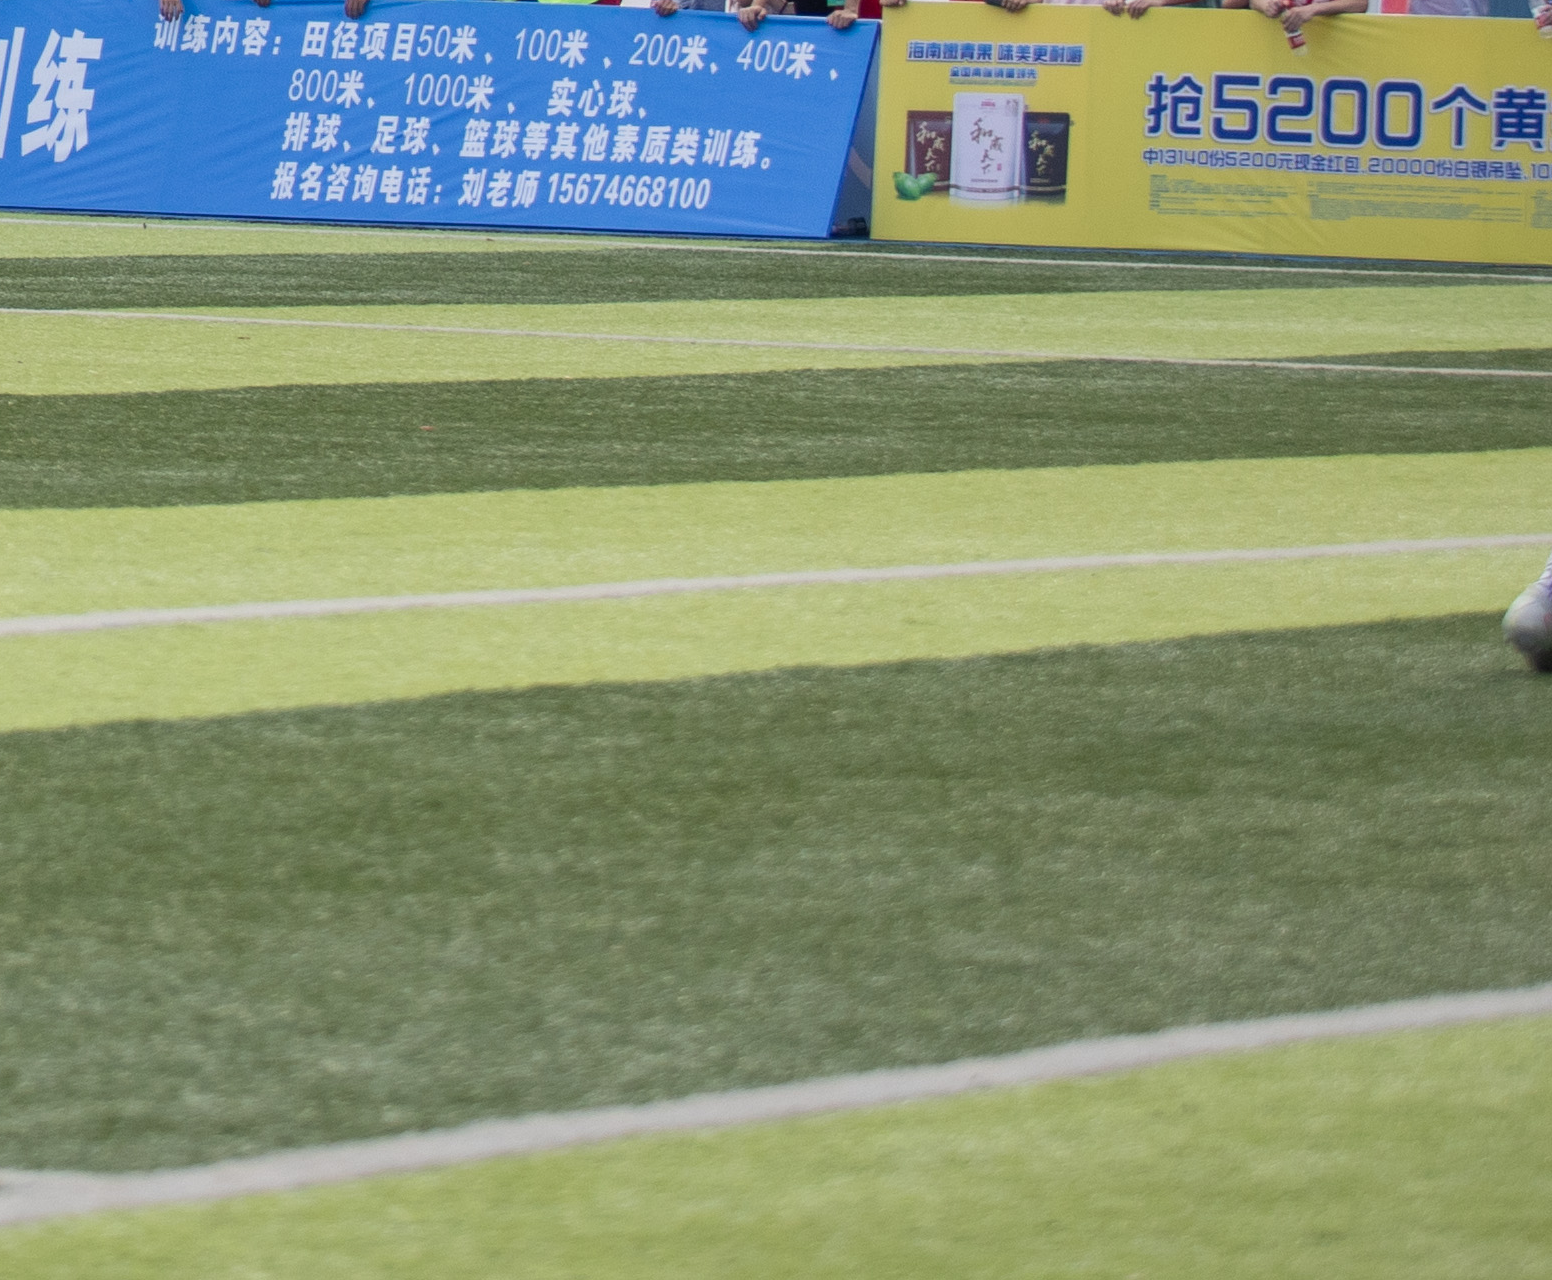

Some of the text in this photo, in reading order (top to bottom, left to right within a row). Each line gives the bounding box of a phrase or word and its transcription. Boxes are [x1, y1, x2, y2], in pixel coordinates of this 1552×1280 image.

[997, 43, 1085, 65] 味美更耐嚼
[1145, 72, 1549, 152] 抢5200个黄
[547, 171, 712, 210] 15674668100
